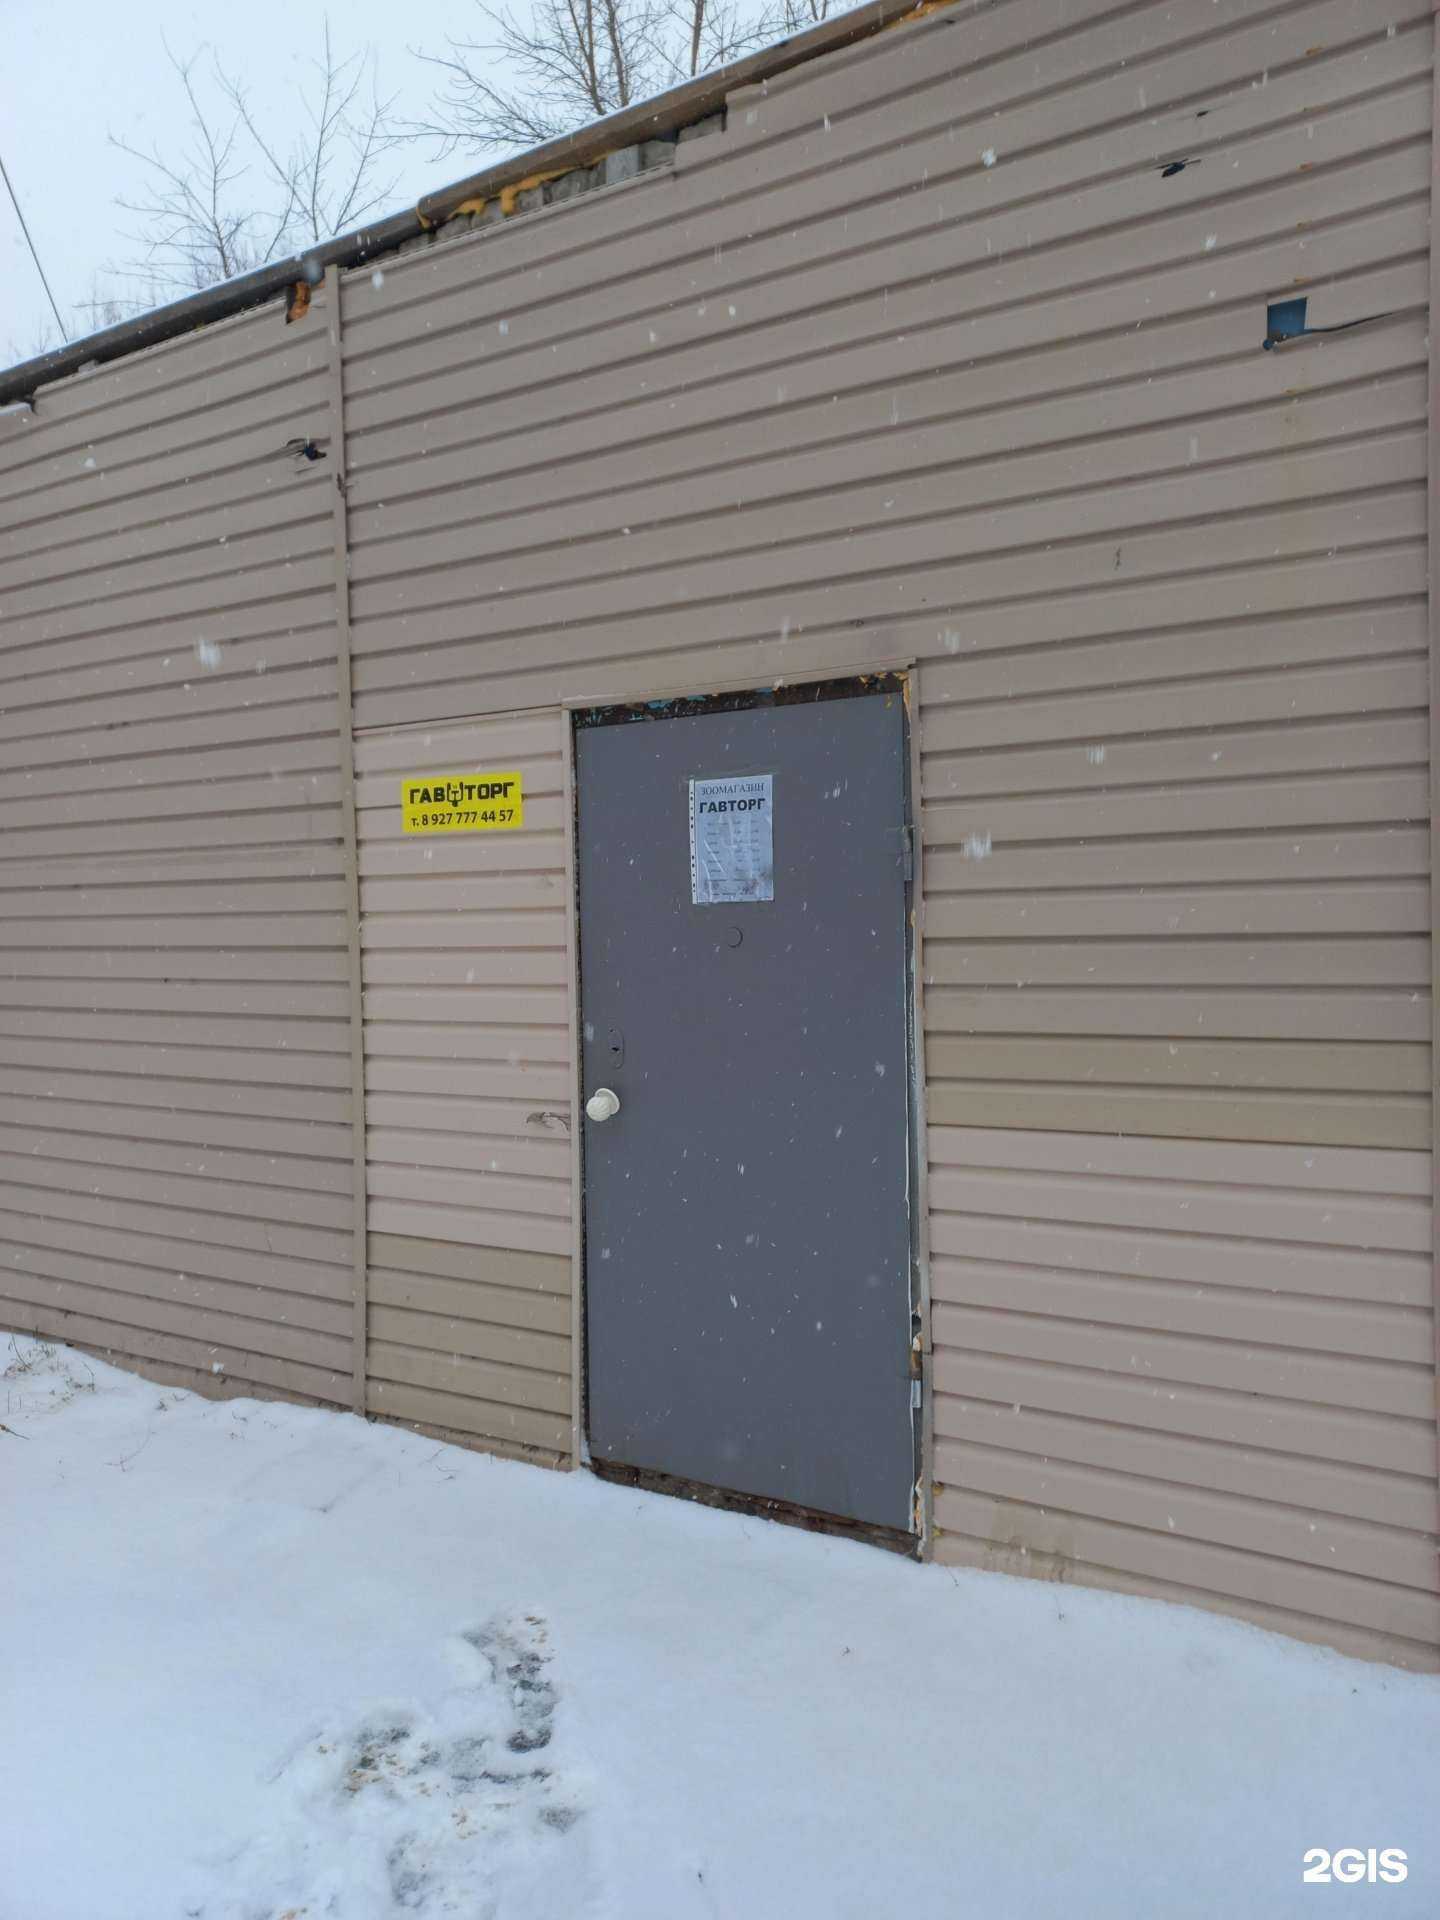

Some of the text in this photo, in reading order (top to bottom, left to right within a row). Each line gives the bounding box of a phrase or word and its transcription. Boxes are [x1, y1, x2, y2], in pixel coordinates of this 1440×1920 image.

[702, 783, 765, 796] ЗООМАГАЗИН
[699, 798, 765, 813] ГАВТОРГ
[422, 814, 429, 826] 8
[431, 813, 453, 825] 927
[456, 811, 477, 824] 777
[481, 811, 496, 823] 44
[499, 809, 514, 822] 57
